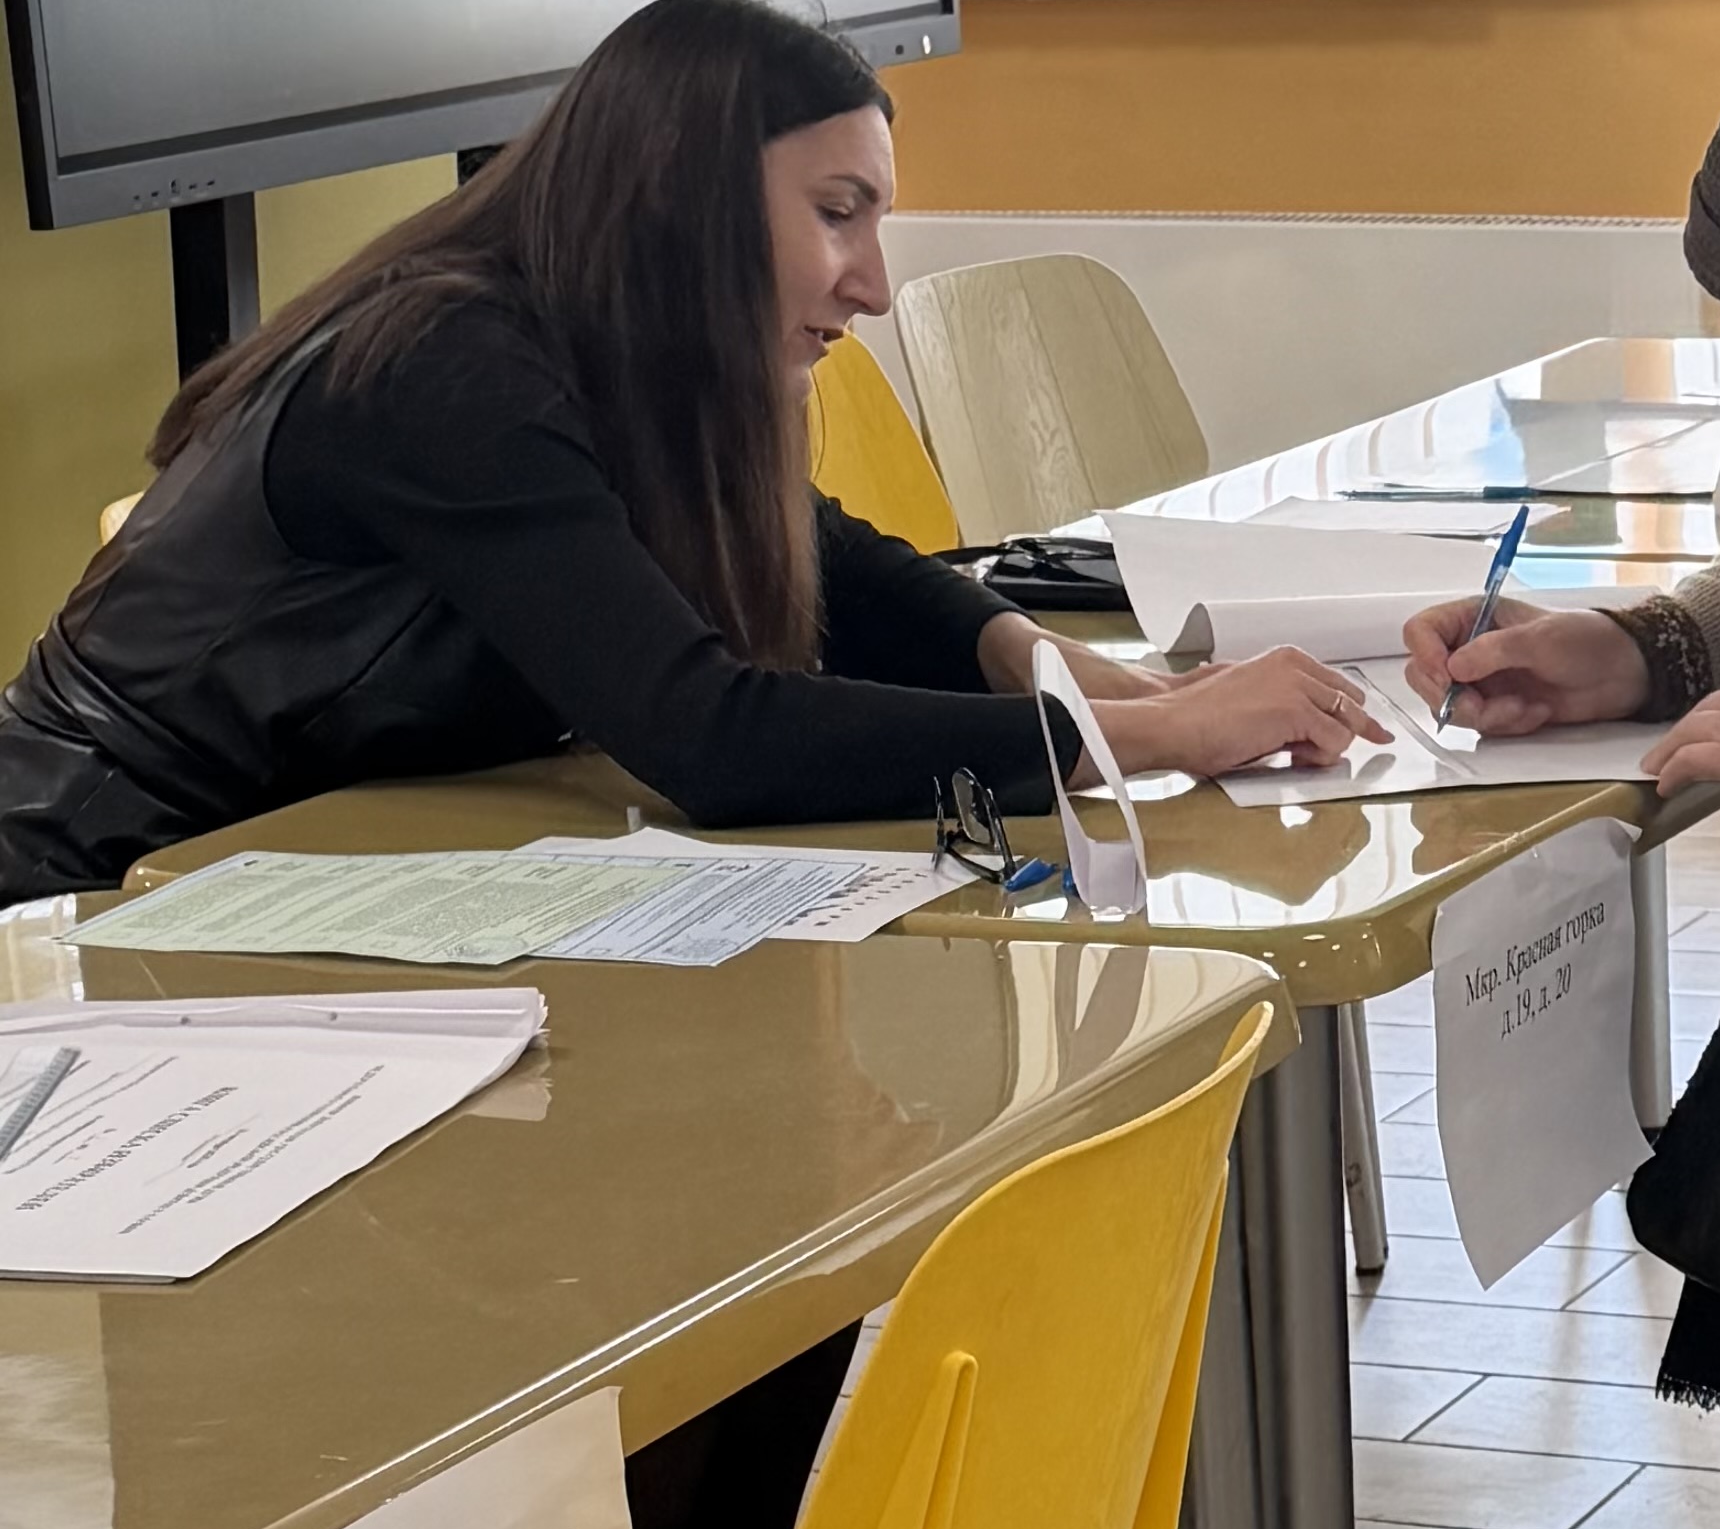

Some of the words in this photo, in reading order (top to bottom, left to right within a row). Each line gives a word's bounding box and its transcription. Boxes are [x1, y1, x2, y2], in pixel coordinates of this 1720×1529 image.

[1465, 967, 1502, 1007] Мкр.
[1505, 926, 1562, 985] Красная
[1566, 902, 1605, 944] горка
[1501, 988, 1535, 1040] д.19,
[1555, 963, 1572, 1001] 20
